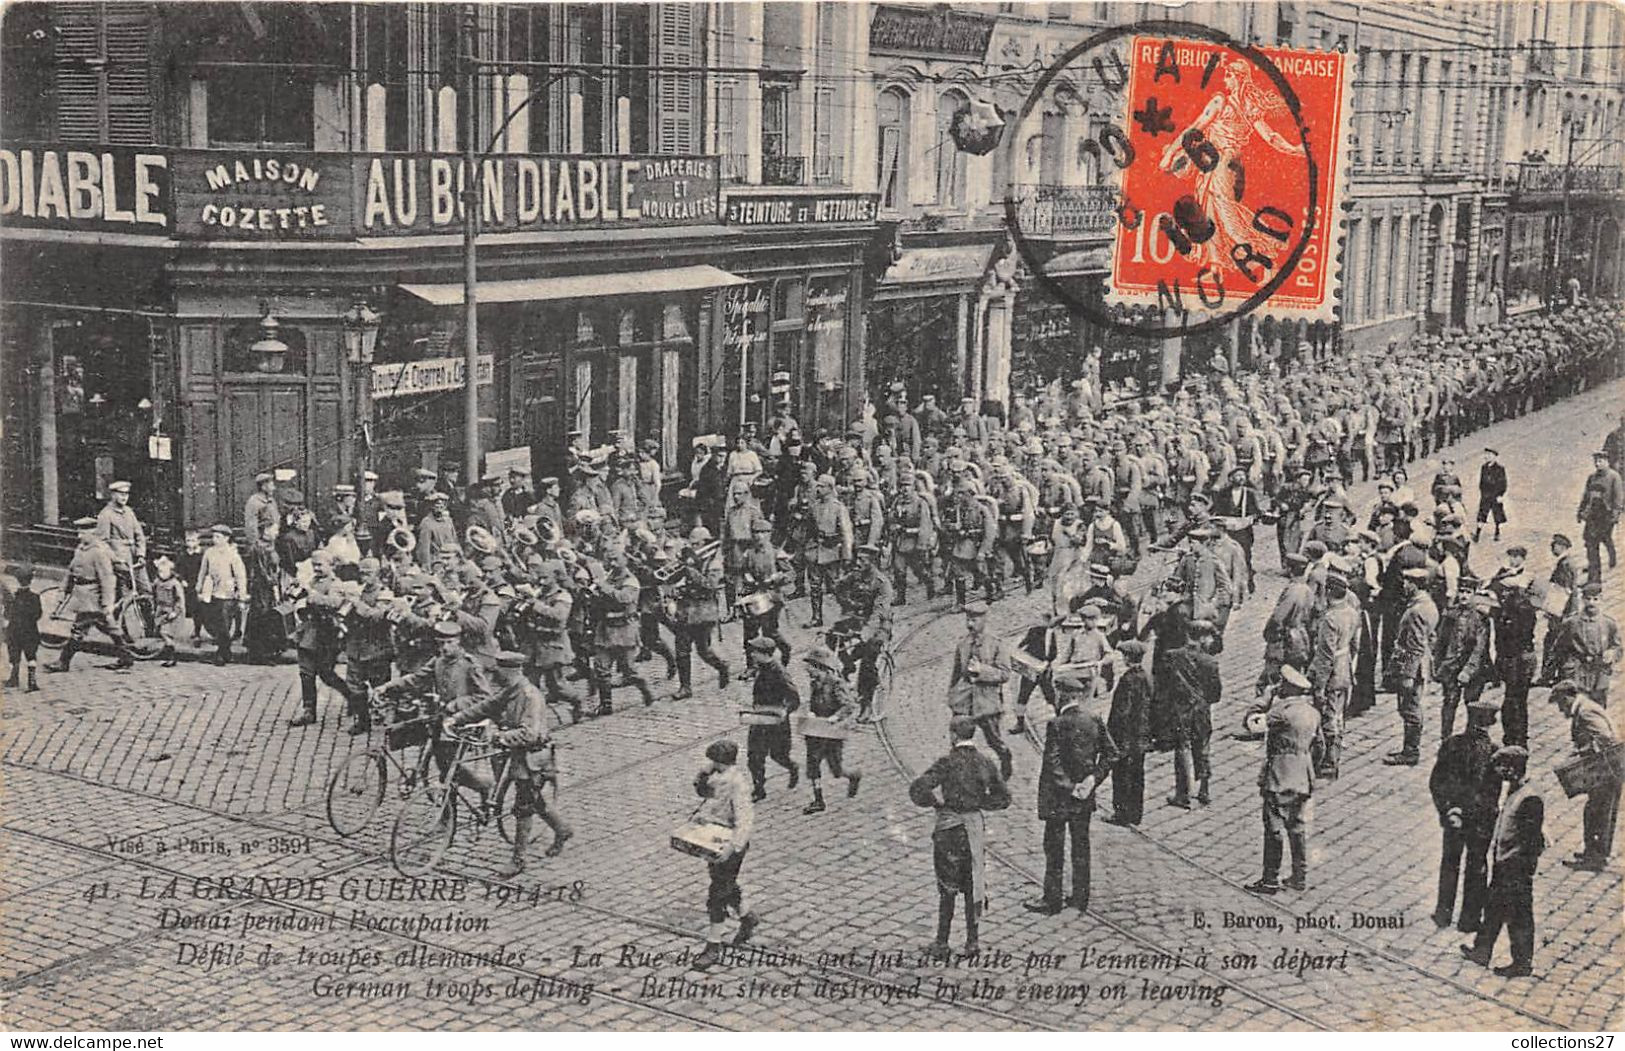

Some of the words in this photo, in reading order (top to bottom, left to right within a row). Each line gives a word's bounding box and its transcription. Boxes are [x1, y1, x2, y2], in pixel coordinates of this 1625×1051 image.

[1142, 45, 1229, 69] REUBLIQE
[1254, 55, 1335, 78] ANÇAISE
[205, 158, 320, 191] MAISON
[646, 159, 712, 180] DRAPERIES
[0, 150, 167, 226] DIABLE
[364, 158, 418, 228] AU
[517, 158, 642, 222] DIABLE
[674, 180, 688, 198] ET
[202, 203, 329, 230] COZETTE
[739, 201, 793, 224] TEINTURE
[798, 206, 808, 222] ET
[815, 199, 869, 222] NETTOYAGE
[1130, 209, 1177, 265] 10
